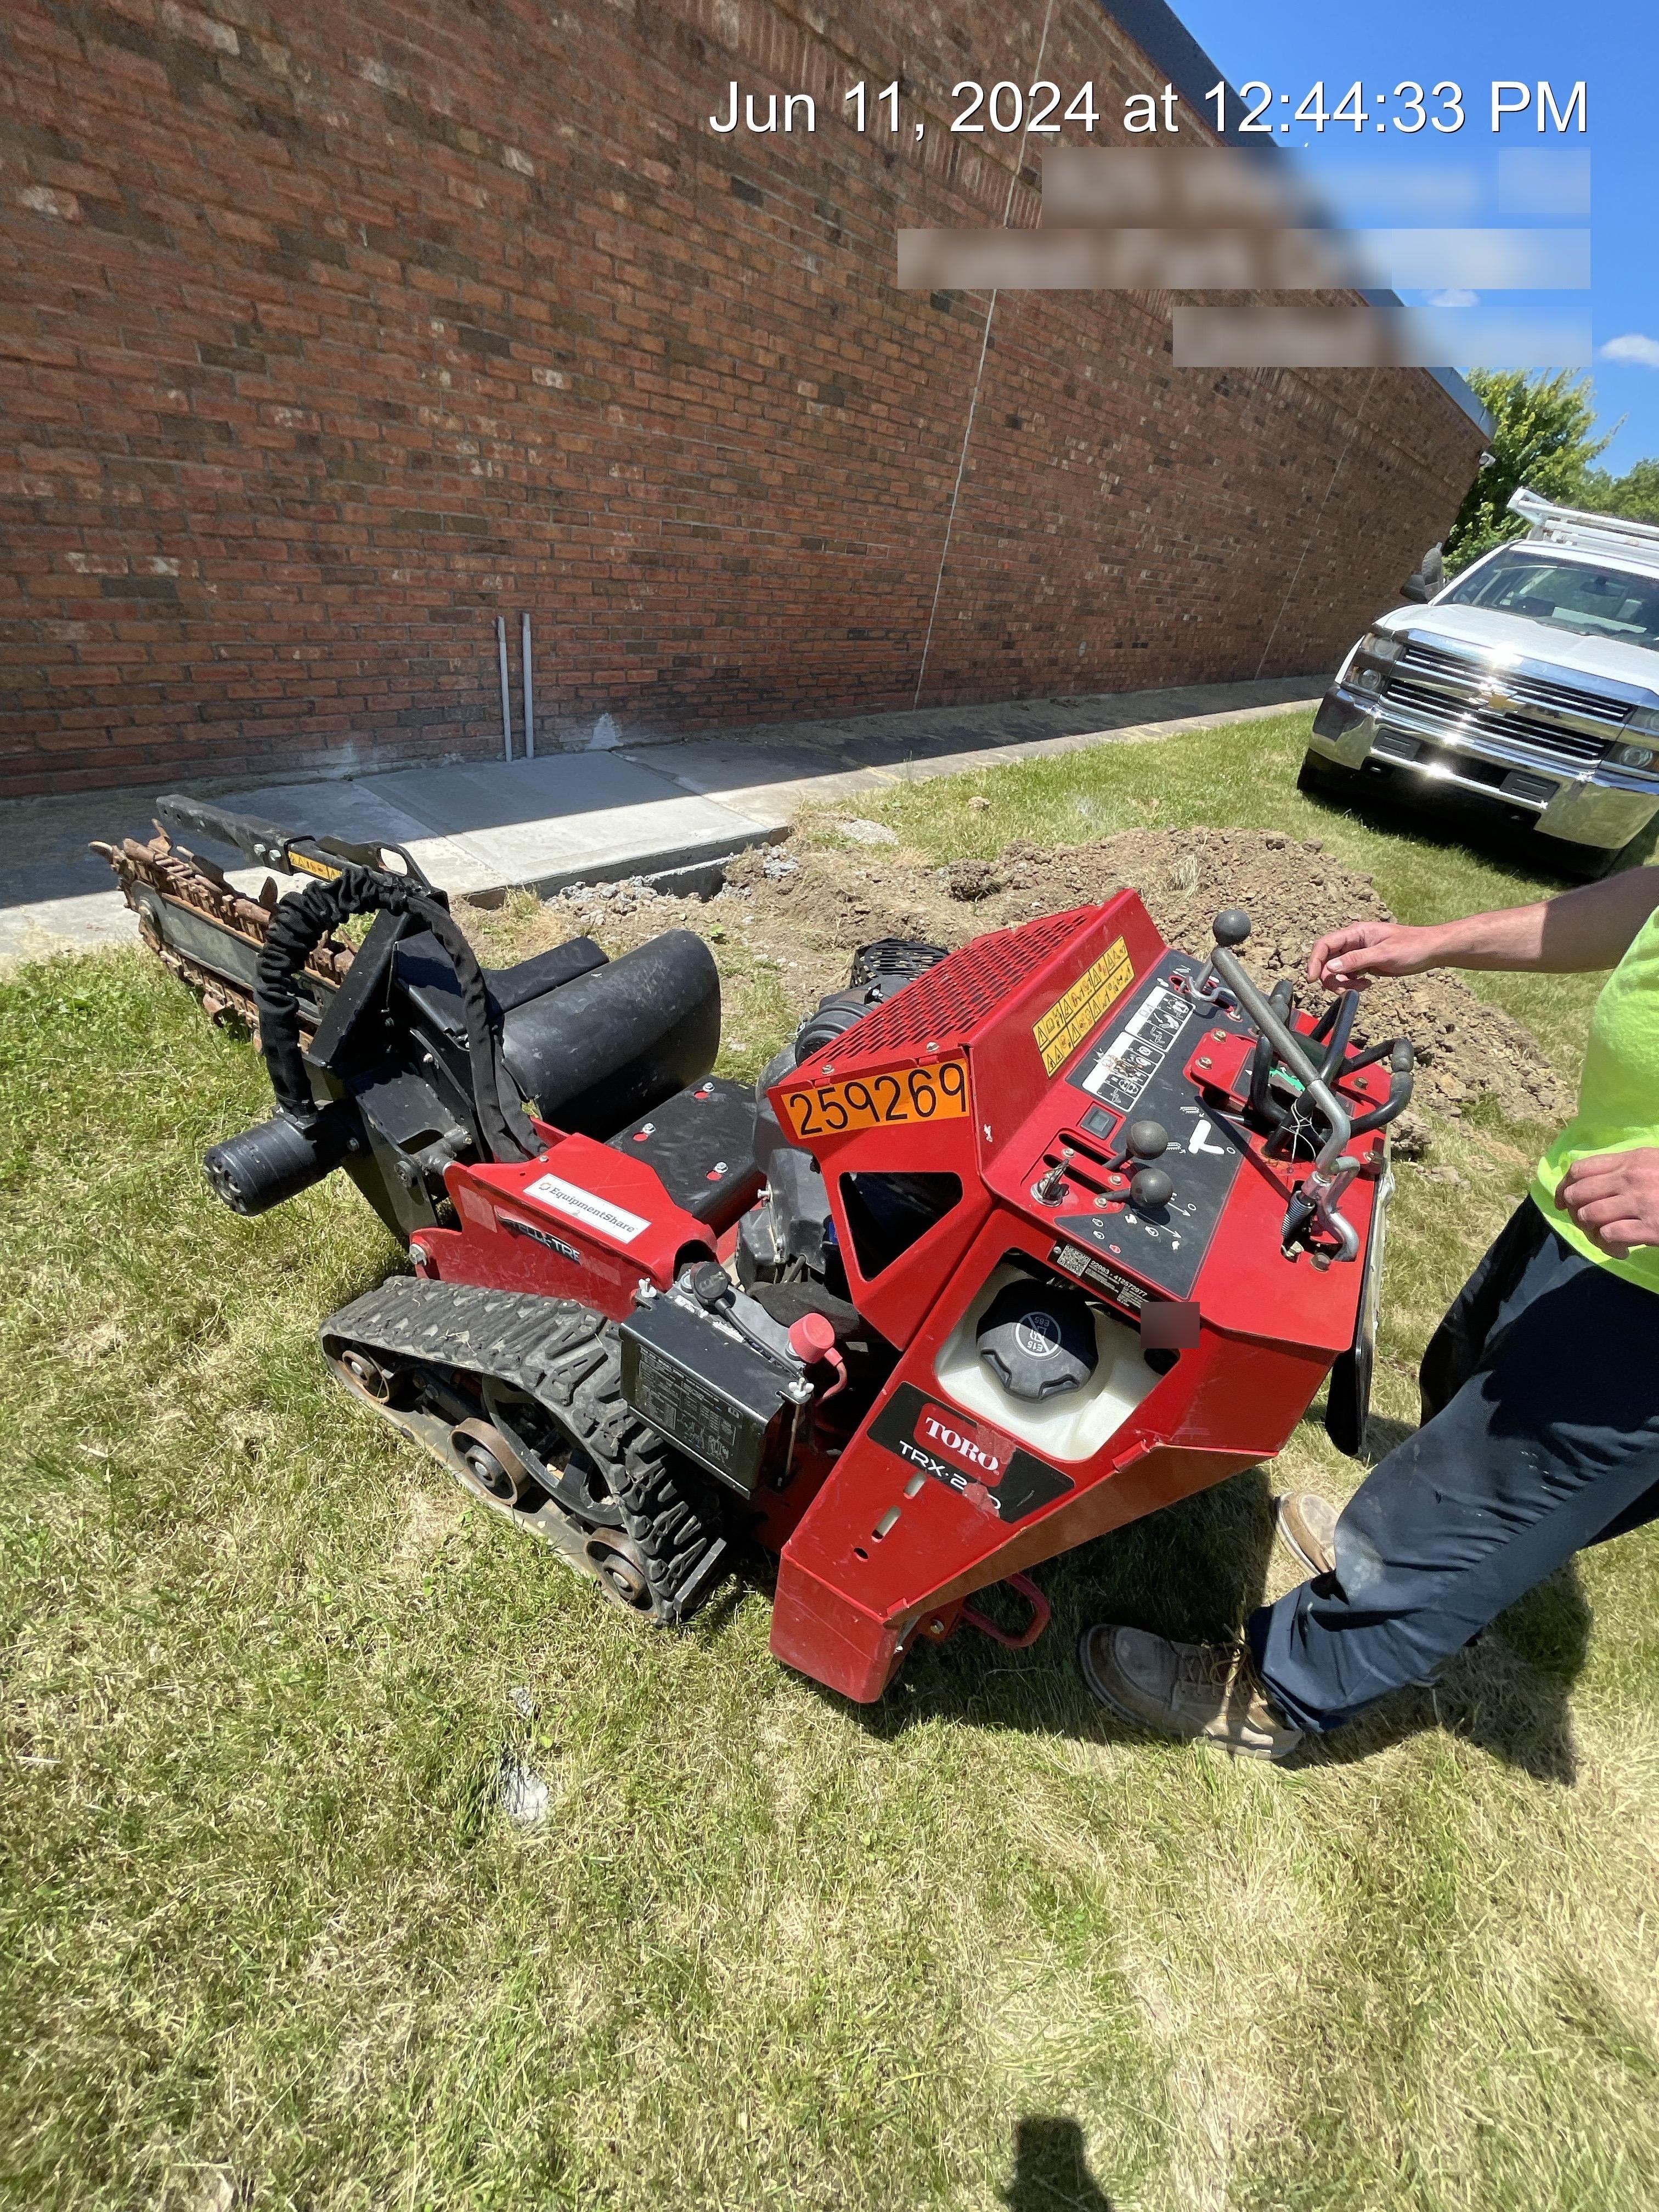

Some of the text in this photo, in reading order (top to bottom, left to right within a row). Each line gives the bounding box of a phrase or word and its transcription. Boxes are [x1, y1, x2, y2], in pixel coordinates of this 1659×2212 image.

[790, 1062, 966, 1136] 259269
[549, 1187, 635, 1233] EquipmentShare
[1027, 1341, 1043, 1352] E15
[926, 1417, 1000, 1471] TORO
[899, 1440, 1001, 1510] TRX-20
